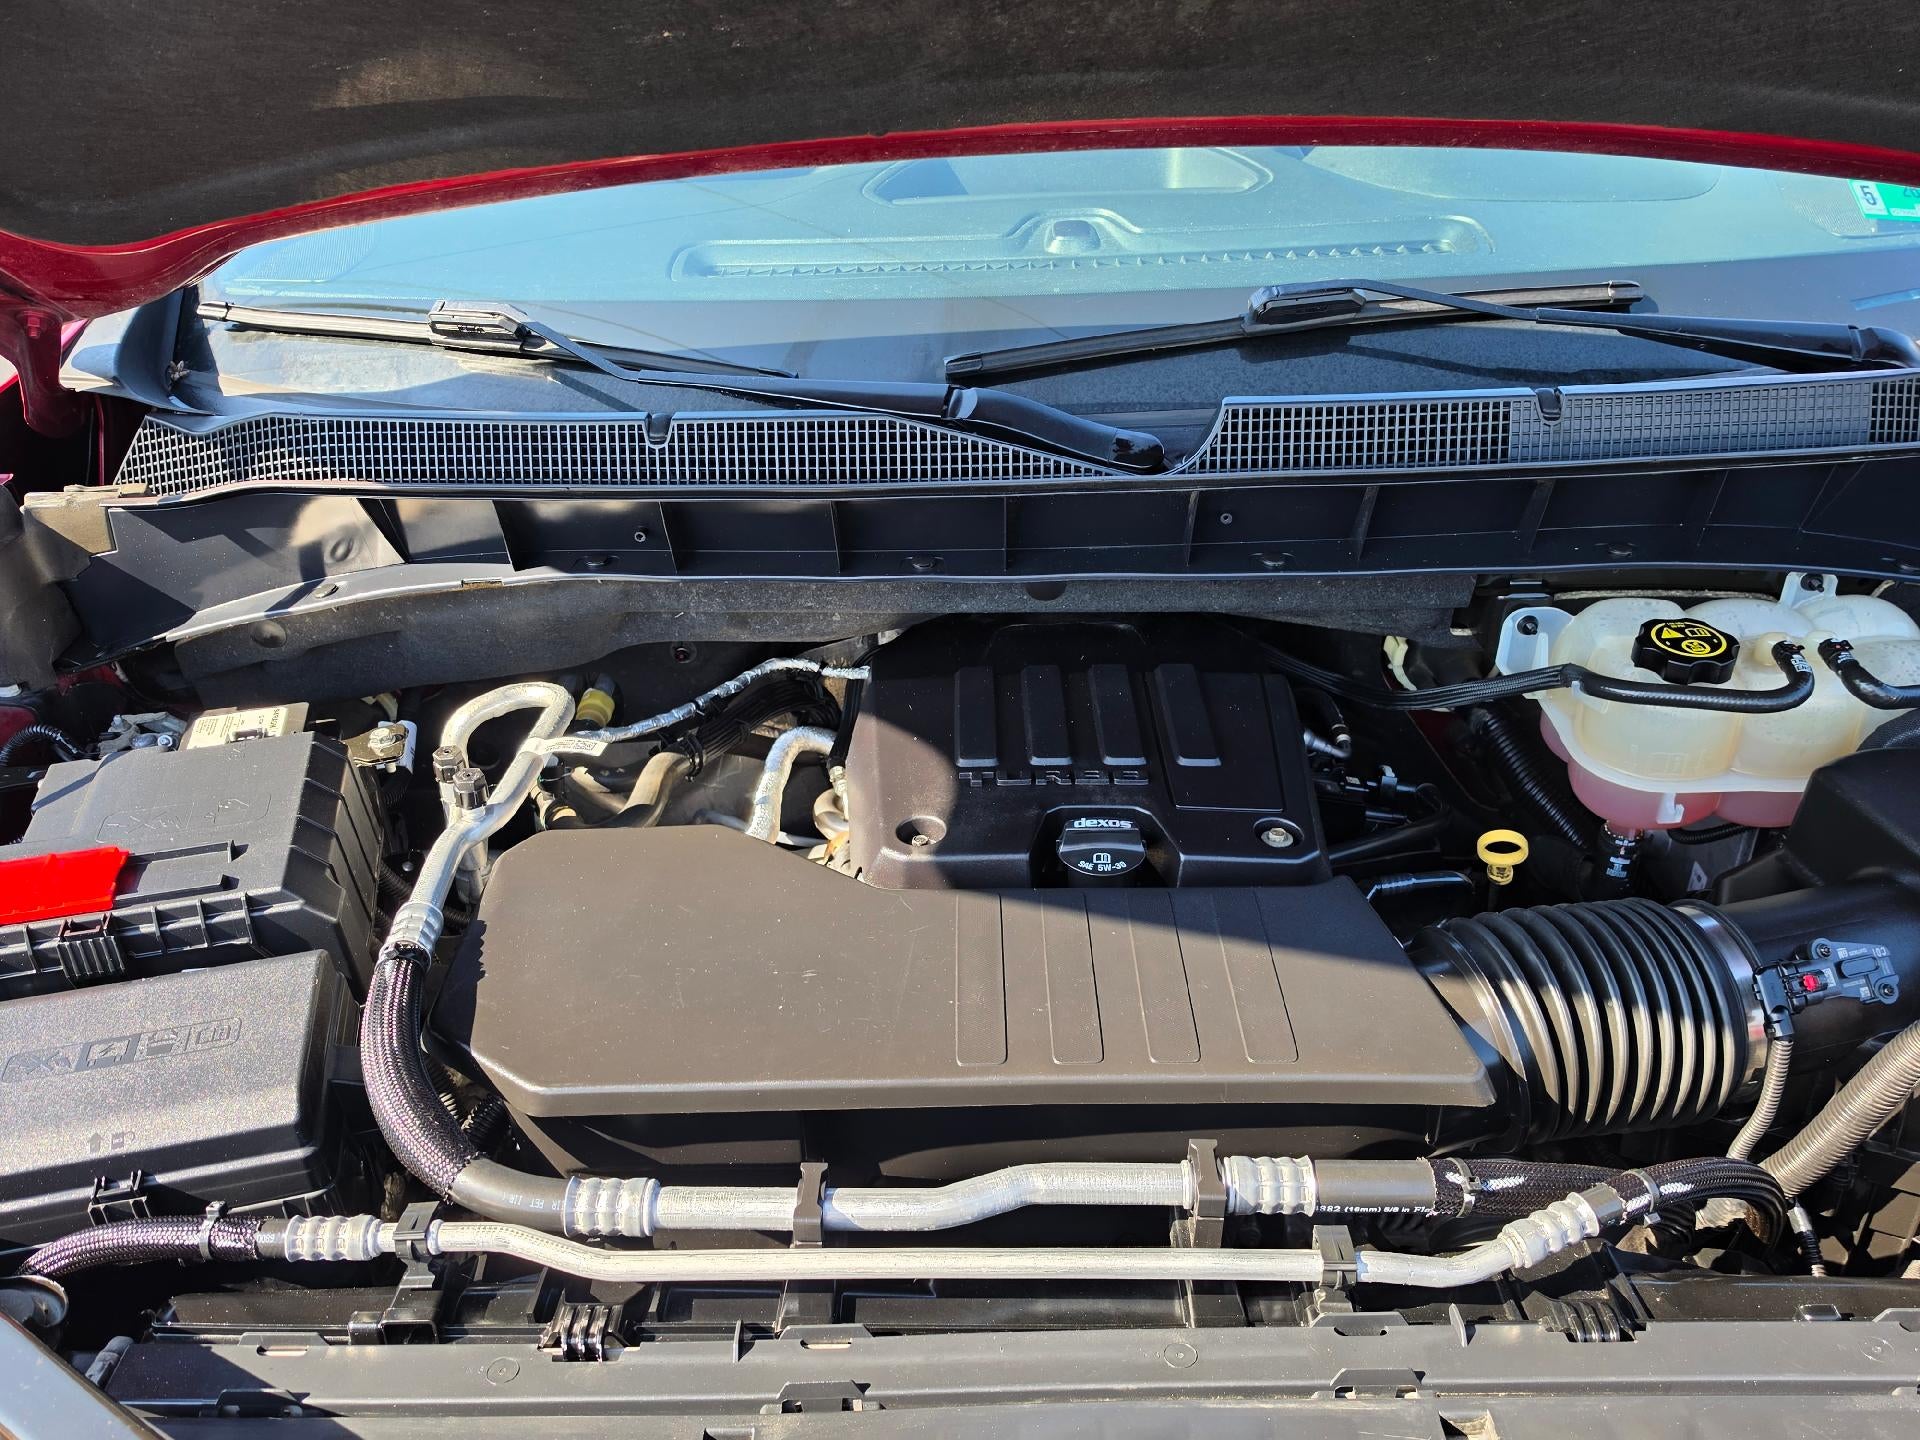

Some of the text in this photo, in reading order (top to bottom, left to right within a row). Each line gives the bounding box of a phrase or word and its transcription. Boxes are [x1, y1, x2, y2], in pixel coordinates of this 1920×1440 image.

[1859, 185, 1877, 206] 5
[1073, 817, 1134, 829] dexos
[1077, 860, 1127, 872] SAE 5W-30
